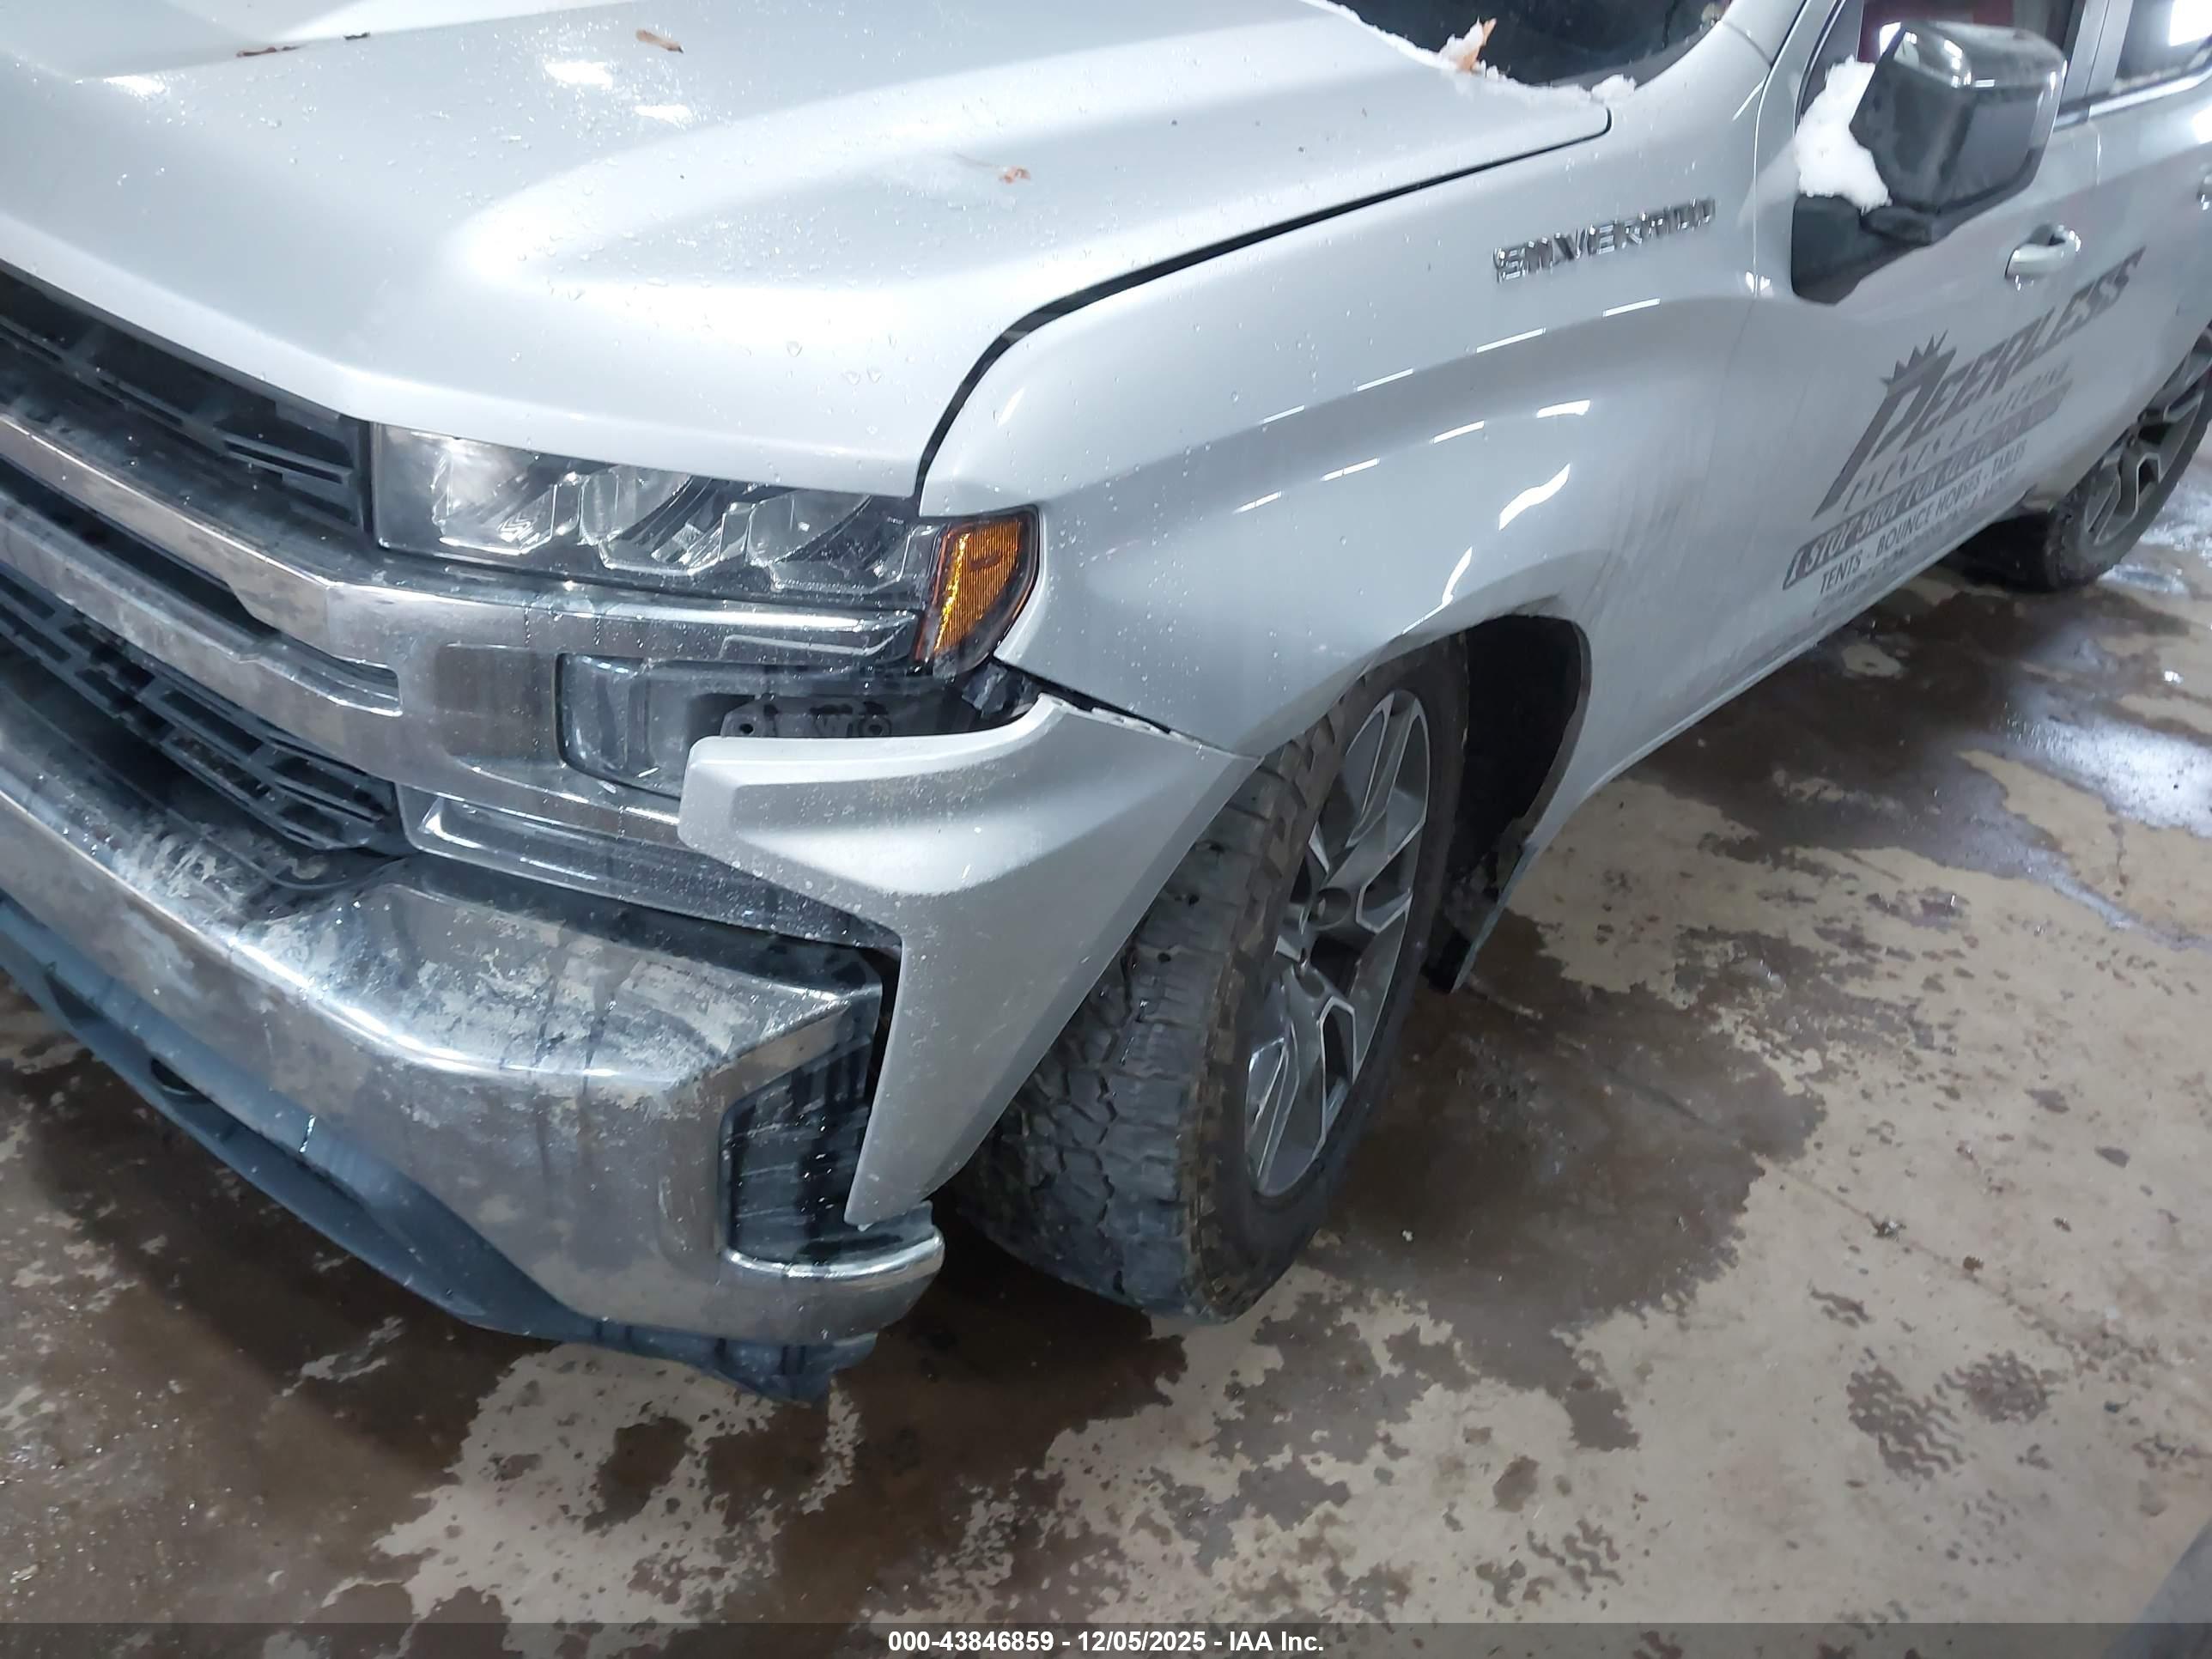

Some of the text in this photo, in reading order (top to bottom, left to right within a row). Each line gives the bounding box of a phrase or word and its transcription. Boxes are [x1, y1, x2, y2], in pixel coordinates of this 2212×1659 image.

[1811, 246, 2146, 520] PEERLESS
[1820, 547, 1863, 594] TENTS
[1875, 500, 1935, 558] BOUNCE
